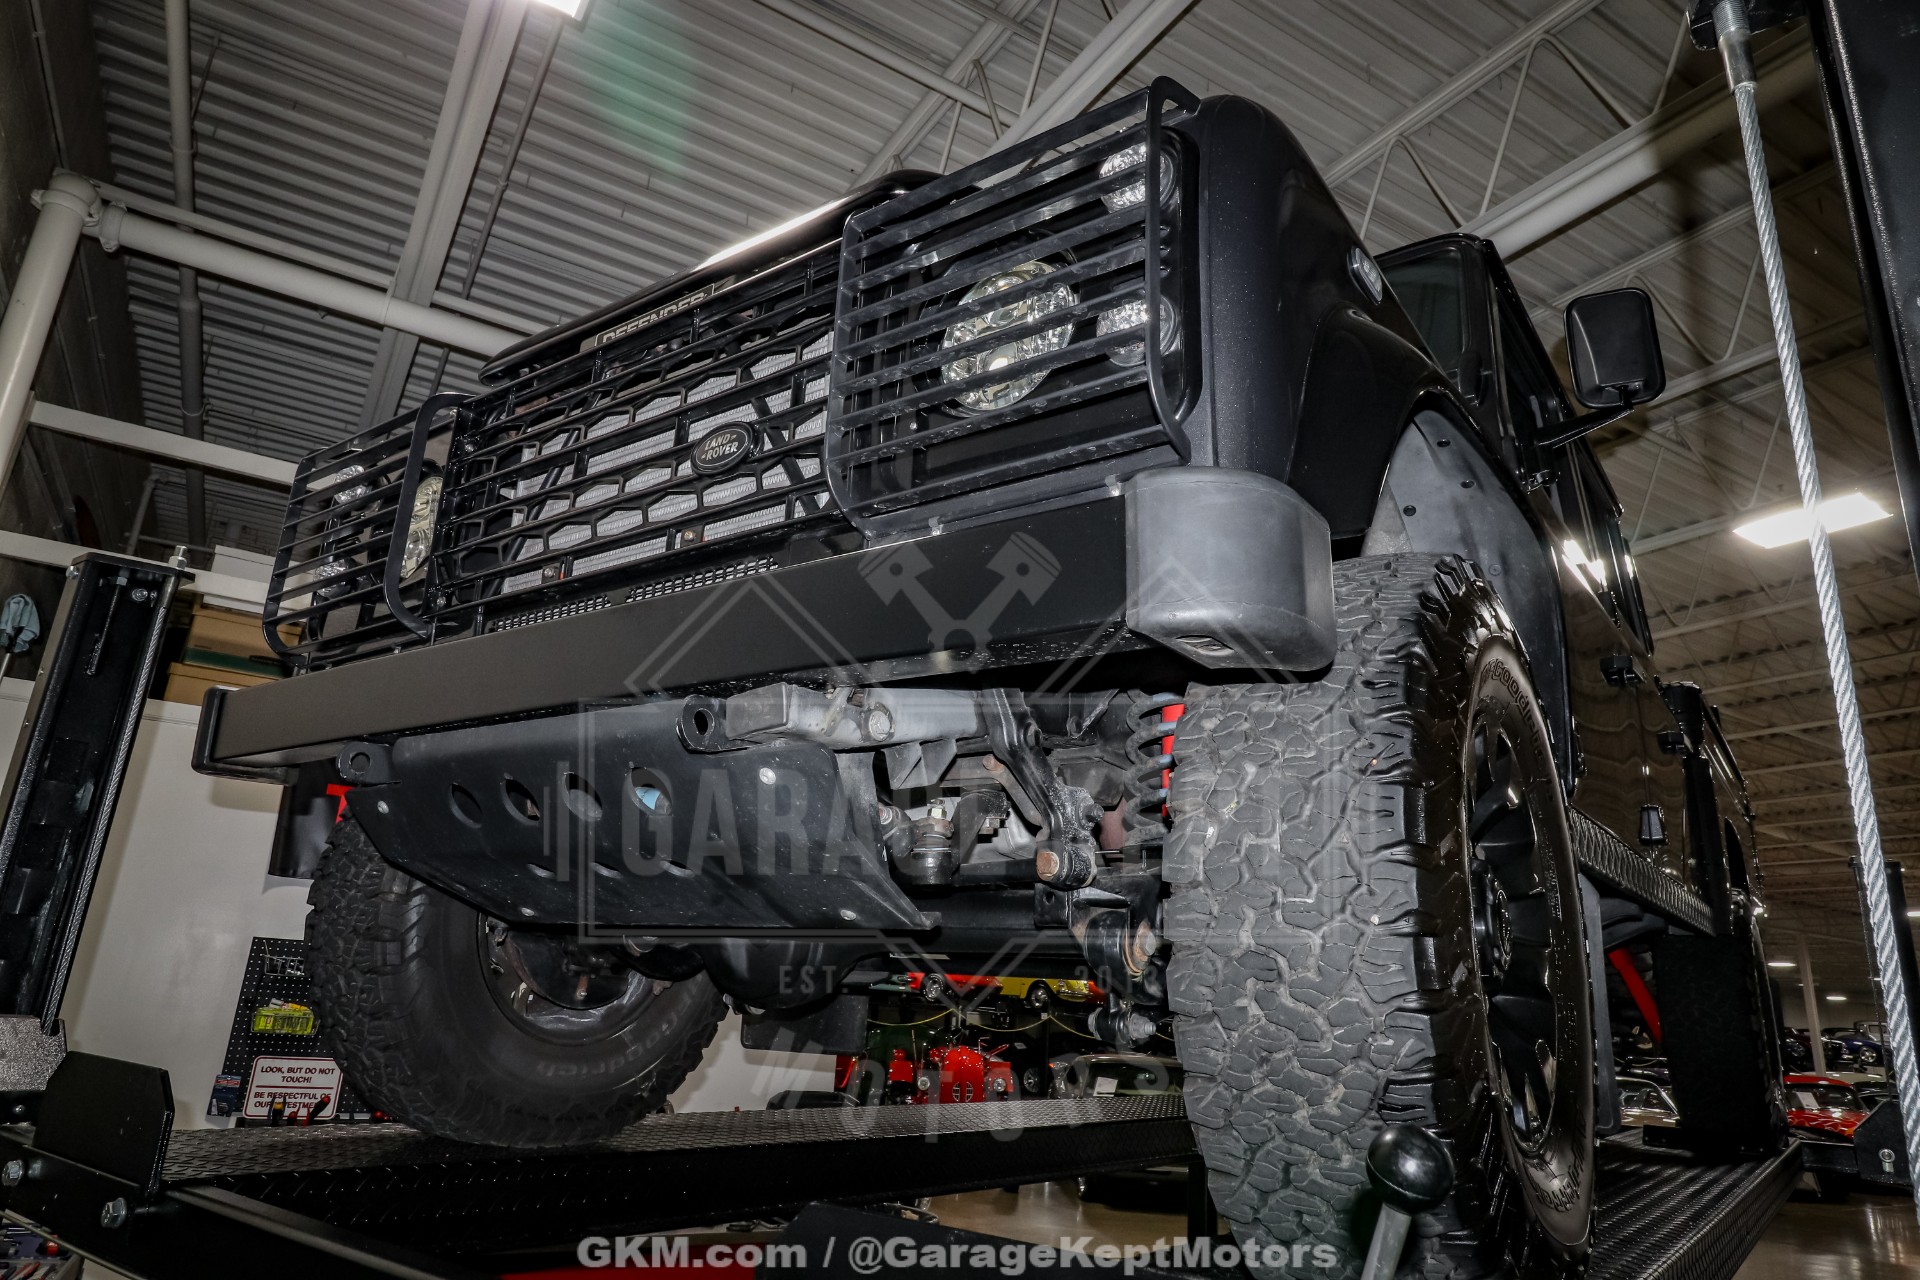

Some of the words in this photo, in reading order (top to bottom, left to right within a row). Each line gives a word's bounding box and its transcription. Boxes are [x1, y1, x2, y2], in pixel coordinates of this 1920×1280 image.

[705, 434, 730, 450] LAND
[706, 441, 739, 461] ROVER
[261, 1066, 285, 1074] LOOK,
[267, 1092, 319, 1100] RESPECTFUL
